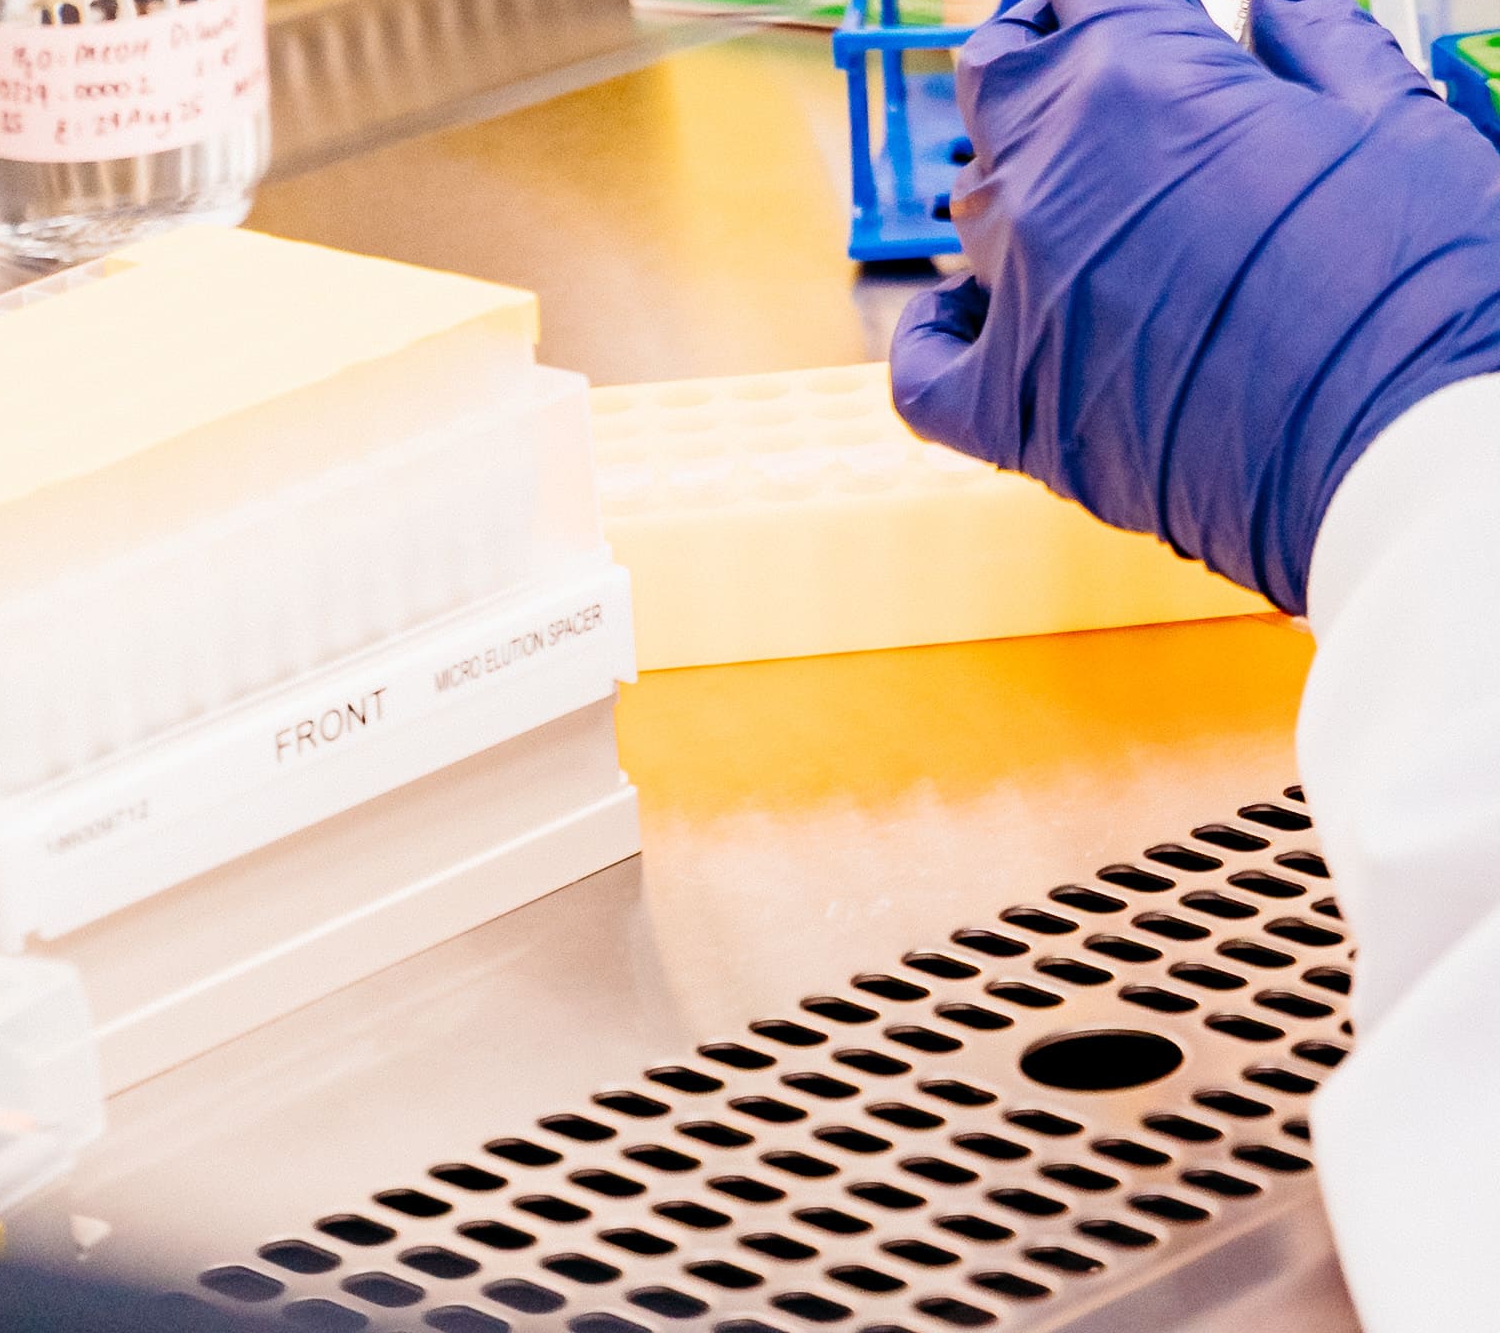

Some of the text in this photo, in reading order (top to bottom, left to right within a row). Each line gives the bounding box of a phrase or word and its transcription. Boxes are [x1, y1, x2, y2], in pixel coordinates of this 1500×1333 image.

[274, 686, 388, 764] FRONT
[433, 655, 481, 693] MICRO
[484, 632, 544, 675] ELUTION
[547, 603, 603, 647] SPACER
